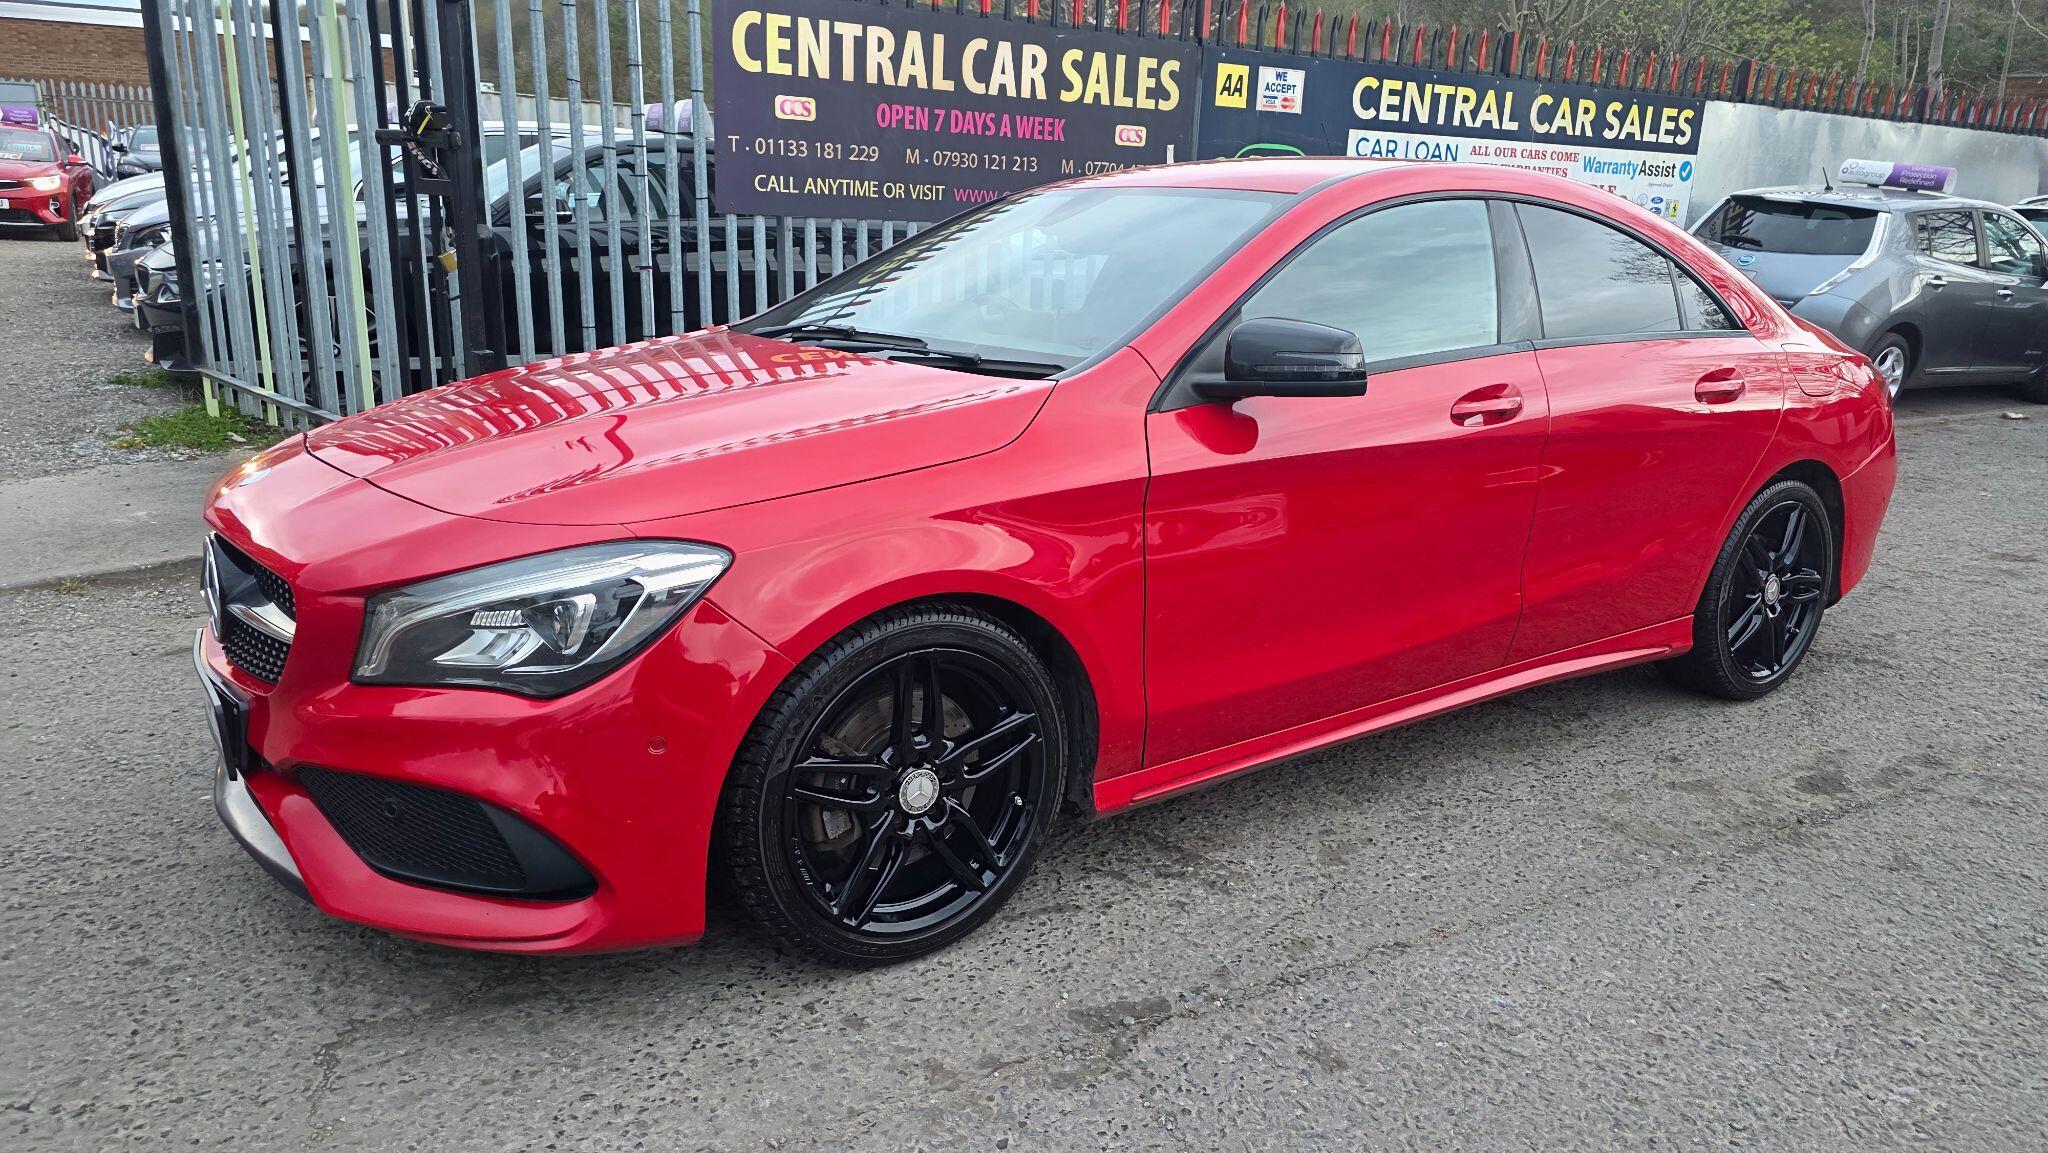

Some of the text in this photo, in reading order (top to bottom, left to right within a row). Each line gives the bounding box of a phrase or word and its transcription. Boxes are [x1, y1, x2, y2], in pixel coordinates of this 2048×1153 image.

[732, 10, 1181, 111] CENTRAL CAR SALES
[1219, 73, 1244, 98] AA
[1264, 81, 1297, 95] ACCEPT
[1275, 70, 1289, 82] WE
[780, 99, 812, 118] CCS
[1352, 76, 1695, 146] CENTRAL CAR SALES
[876, 103, 1066, 142] OPEN 7 DAYS A WEEK
[1118, 128, 1143, 144] CCS
[754, 137, 808, 158] 01133
[814, 142, 842, 160] 181
[848, 144, 879, 162] 229
[933, 150, 978, 168] 07930
[984, 154, 1007, 170] 121
[1012, 156, 1038, 172] 213
[1355, 136, 1459, 162] CAR LOAN
[1469, 145, 1580, 163] ALL OUR CARS COME
[754, 174, 799, 193] CALL
[804, 177, 879, 198] ANYTIME
[883, 182, 905, 199] OR
[909, 183, 946, 200] VISIT
